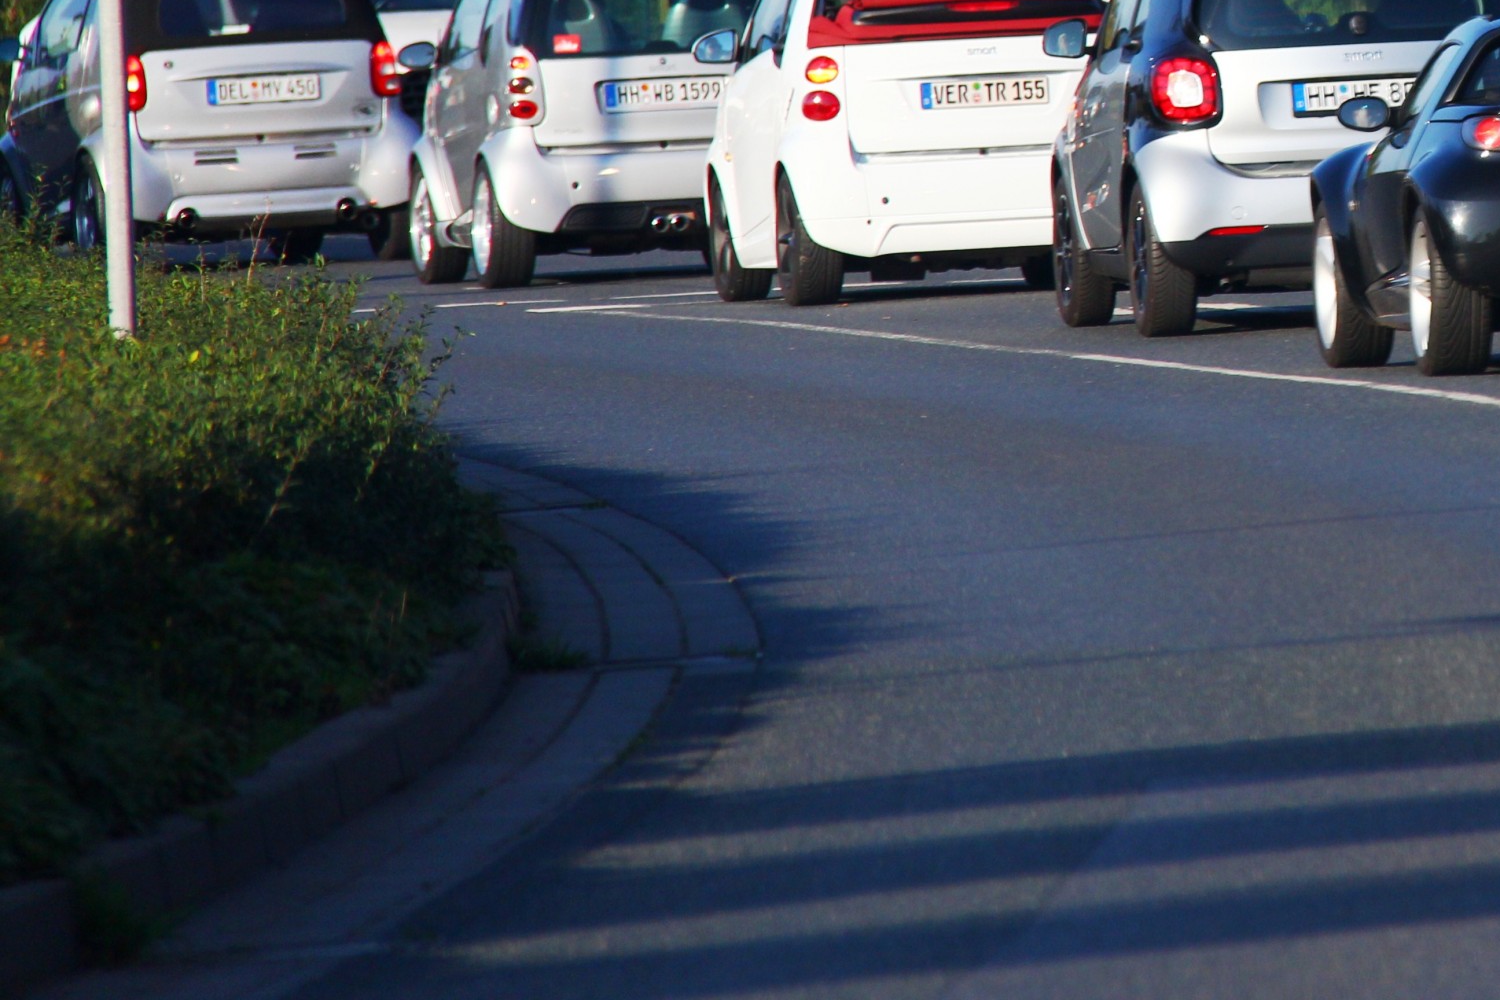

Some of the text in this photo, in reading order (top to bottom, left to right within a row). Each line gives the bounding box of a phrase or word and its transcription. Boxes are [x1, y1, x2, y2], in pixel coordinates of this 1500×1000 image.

[967, 46, 997, 56] smart
[219, 78, 316, 101] DEL MV 450
[617, 80, 721, 104] HH WB 1599
[934, 81, 1045, 105] VER TR 155
[1307, 85, 1336, 110] HH
